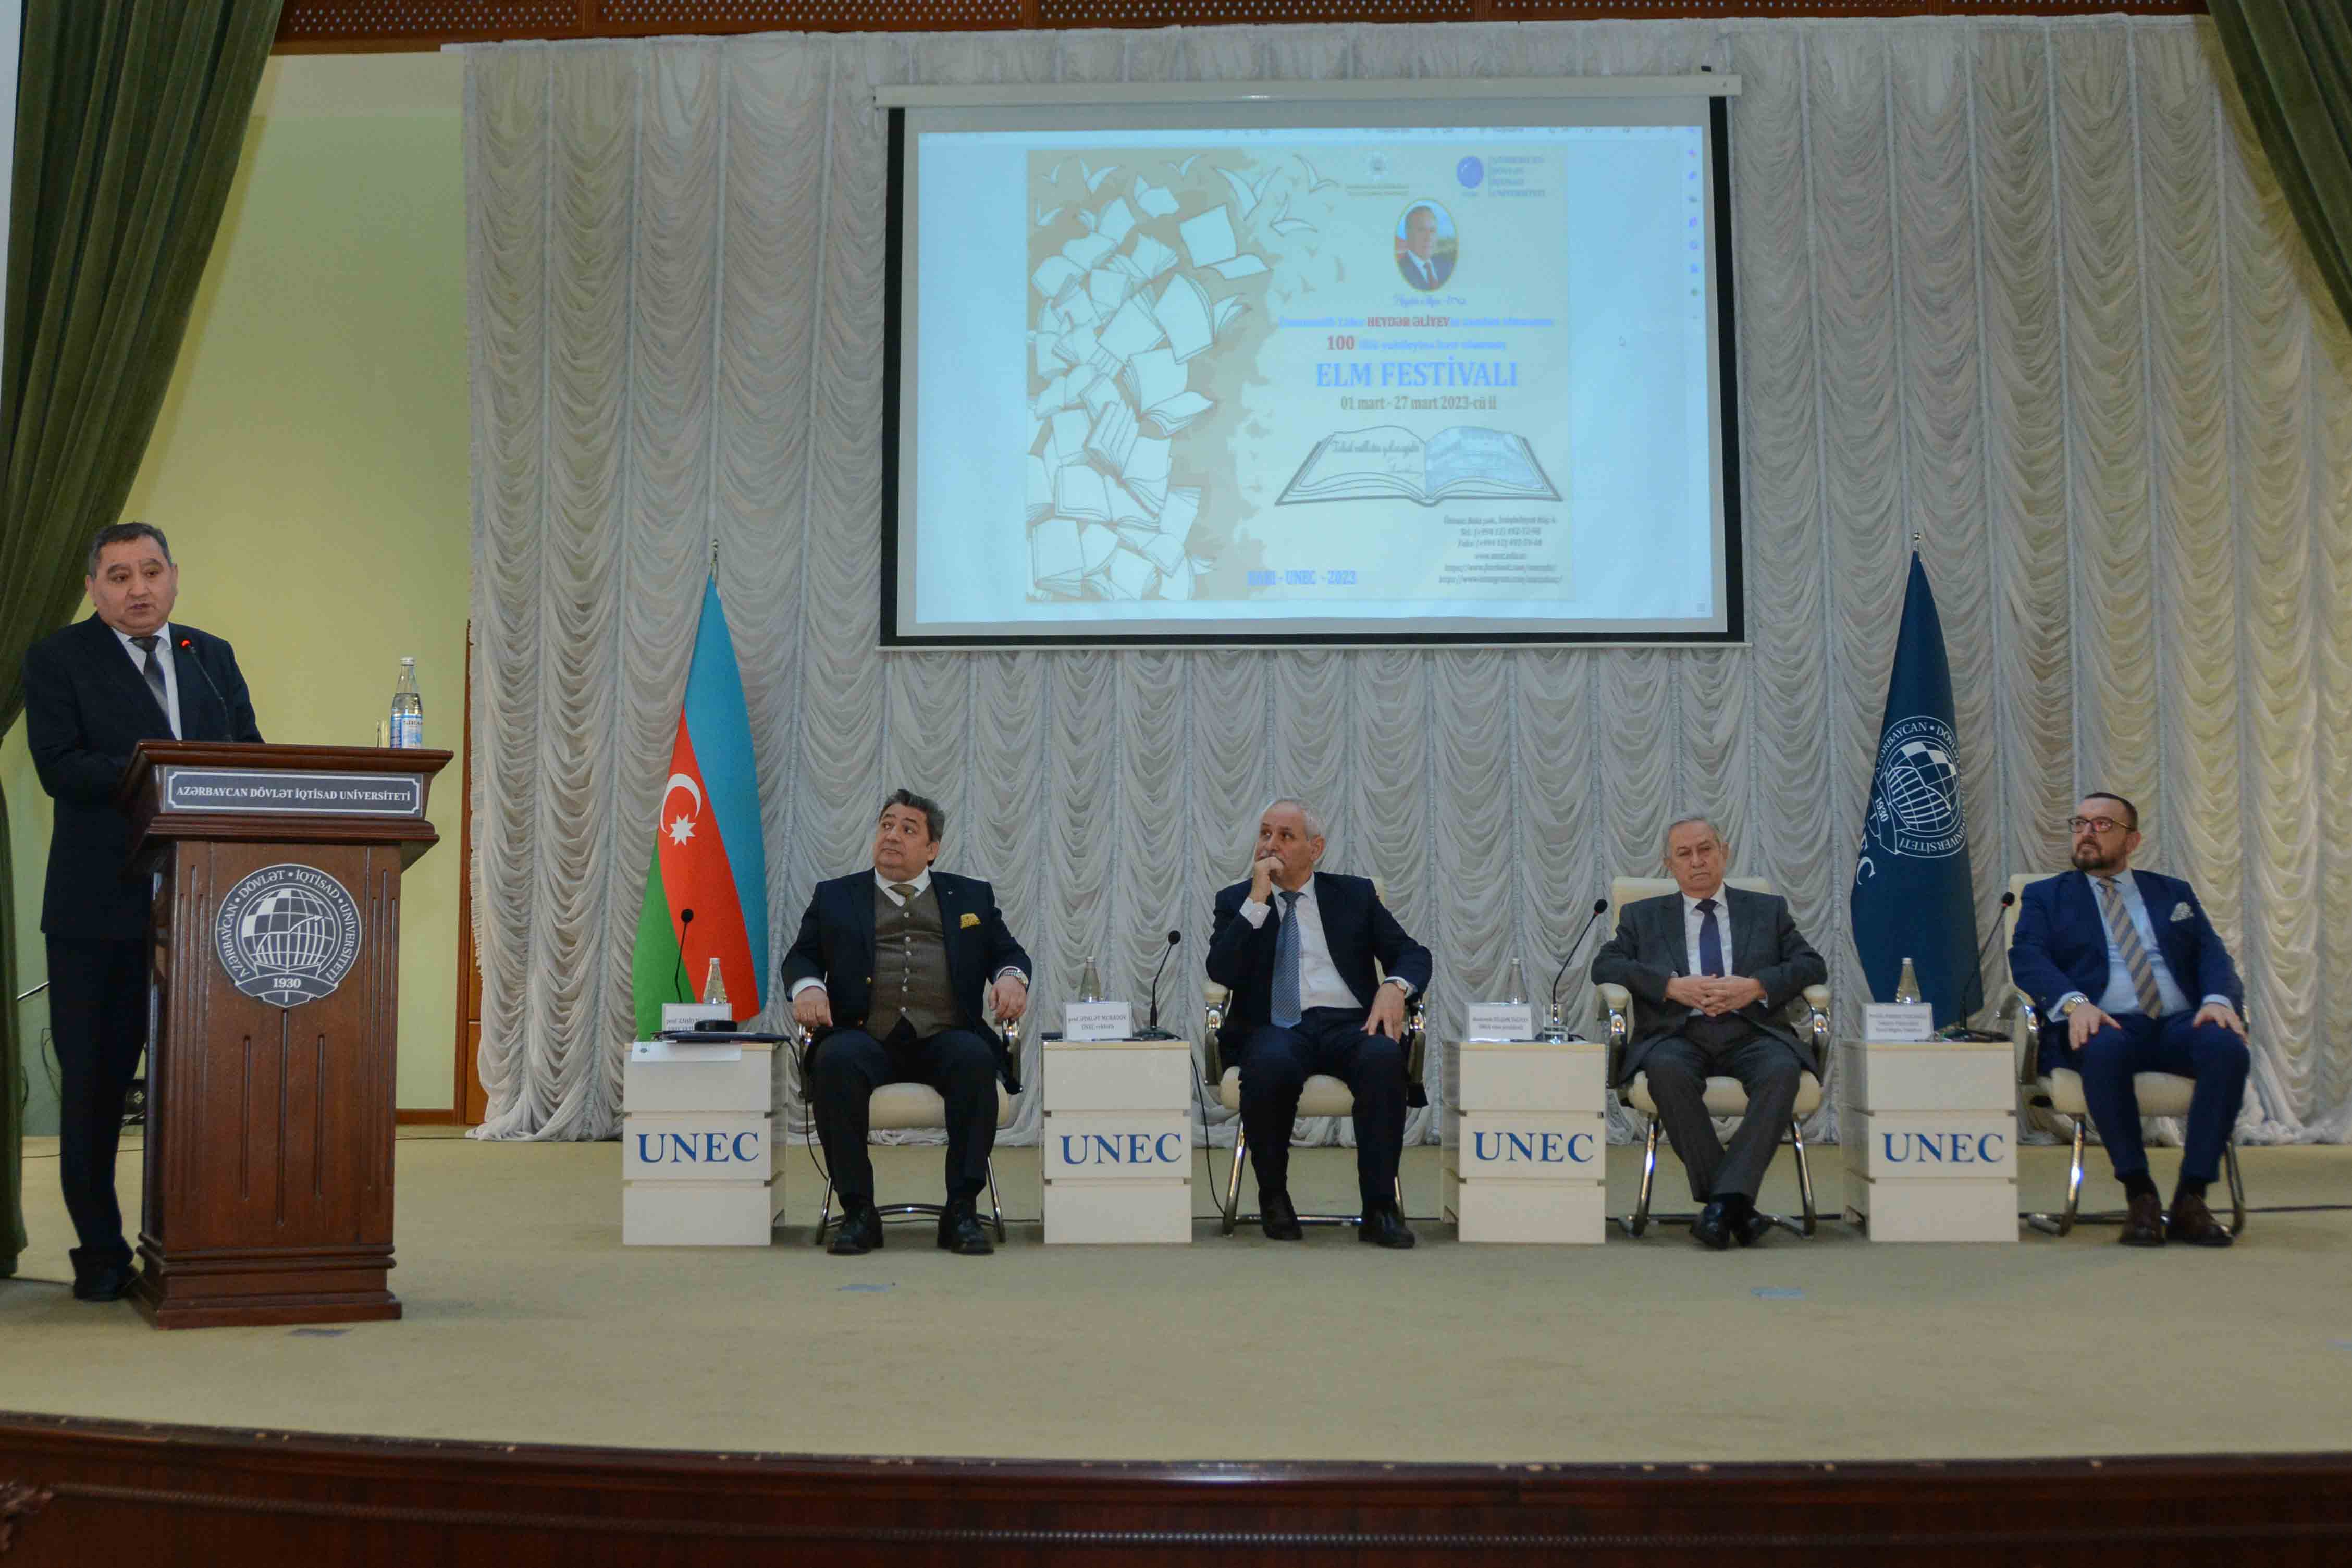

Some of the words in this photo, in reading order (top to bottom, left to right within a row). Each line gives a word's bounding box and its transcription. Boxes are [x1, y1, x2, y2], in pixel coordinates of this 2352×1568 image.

[1327, 335, 1355, 351] 100
[1316, 362, 1372, 387] ELM
[1380, 354, 1518, 387] FESTİVALI
[1340, 396, 1356, 410] 01
[1358, 397, 1385, 410] mart
[1394, 396, 1408, 410] 27
[1411, 397, 1439, 410] mart
[1285, 570, 1316, 584] UNEC
[1327, 570, 1356, 584] 2023
[176, 786, 248, 797] AZƏRBAYCAN
[250, 787, 293, 798] DÖVLƏT
[295, 788, 338, 800] İQTİSAD
[339, 789, 411, 801] UNİVERSİTETİ
[1875, 797, 1889, 822] 1930
[220, 903, 251, 978] AZƏRBAYCAN
[295, 869, 340, 899] İQTİSAD
[325, 903, 357, 982] UNİVERSİTETİ
[272, 978, 302, 989] 1930
[636, 1132, 759, 1163] UNEC
[1060, 1133, 1181, 1164] UNEC
[1473, 1131, 1593, 1163] UNEC
[1882, 1132, 2005, 1163] UNEC
